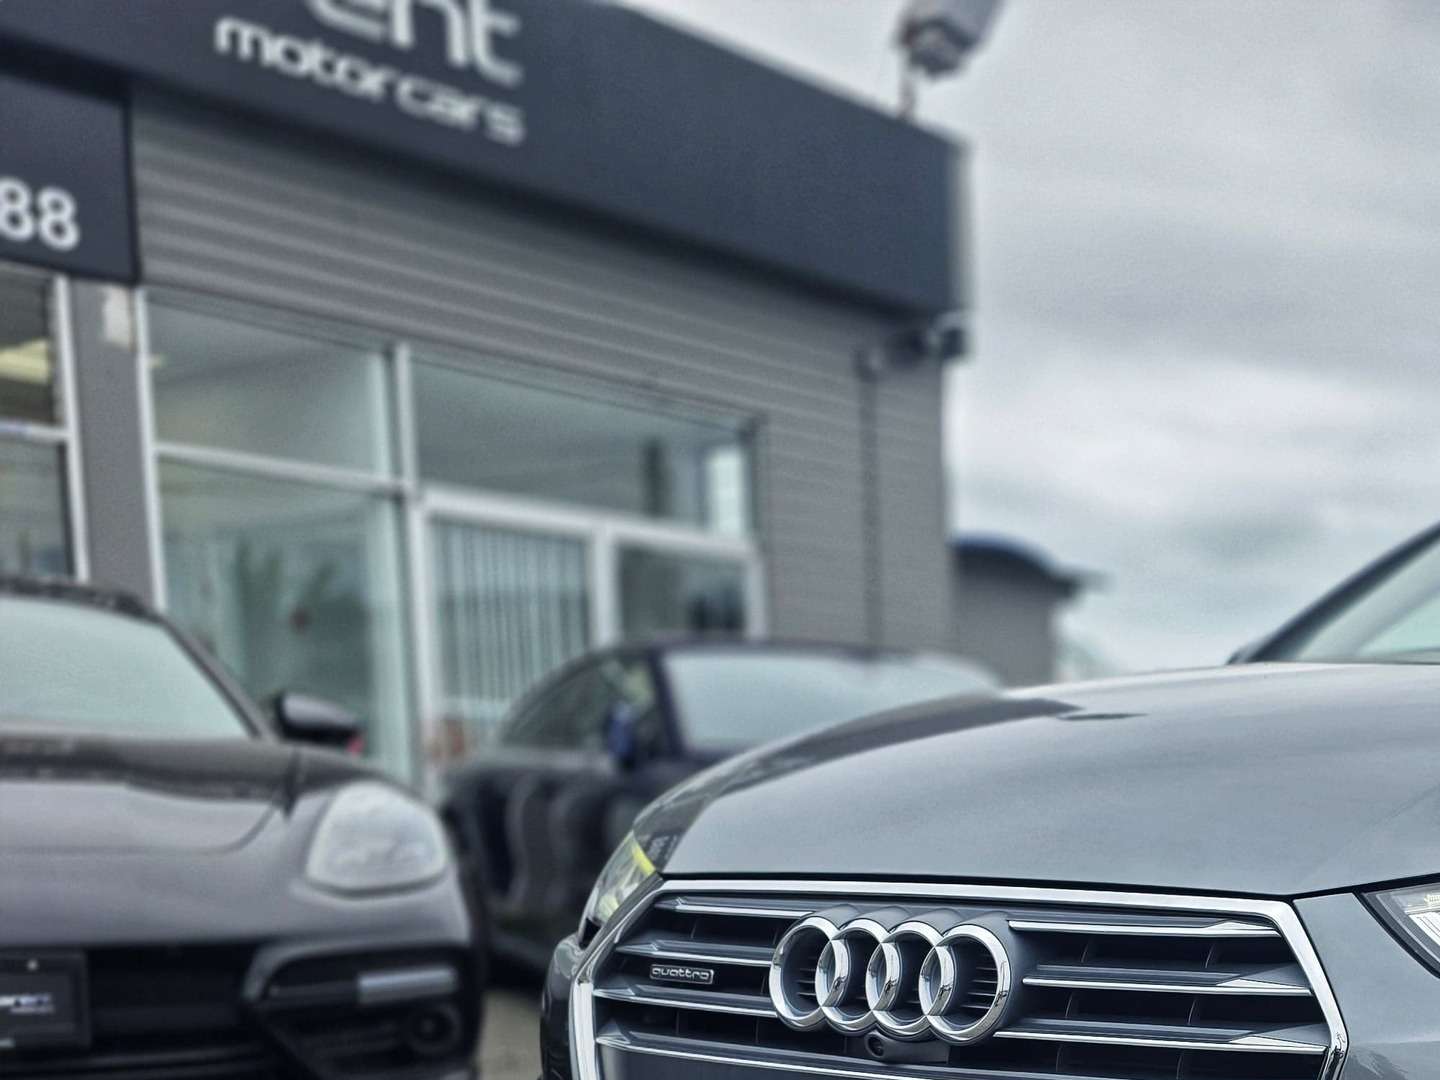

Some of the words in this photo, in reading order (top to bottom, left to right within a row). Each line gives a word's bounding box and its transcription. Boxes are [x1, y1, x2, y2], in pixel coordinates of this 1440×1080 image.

[214, 16, 526, 146] motorcars
[0, 176, 81, 251] 88
[651, 966, 710, 981] quattro
